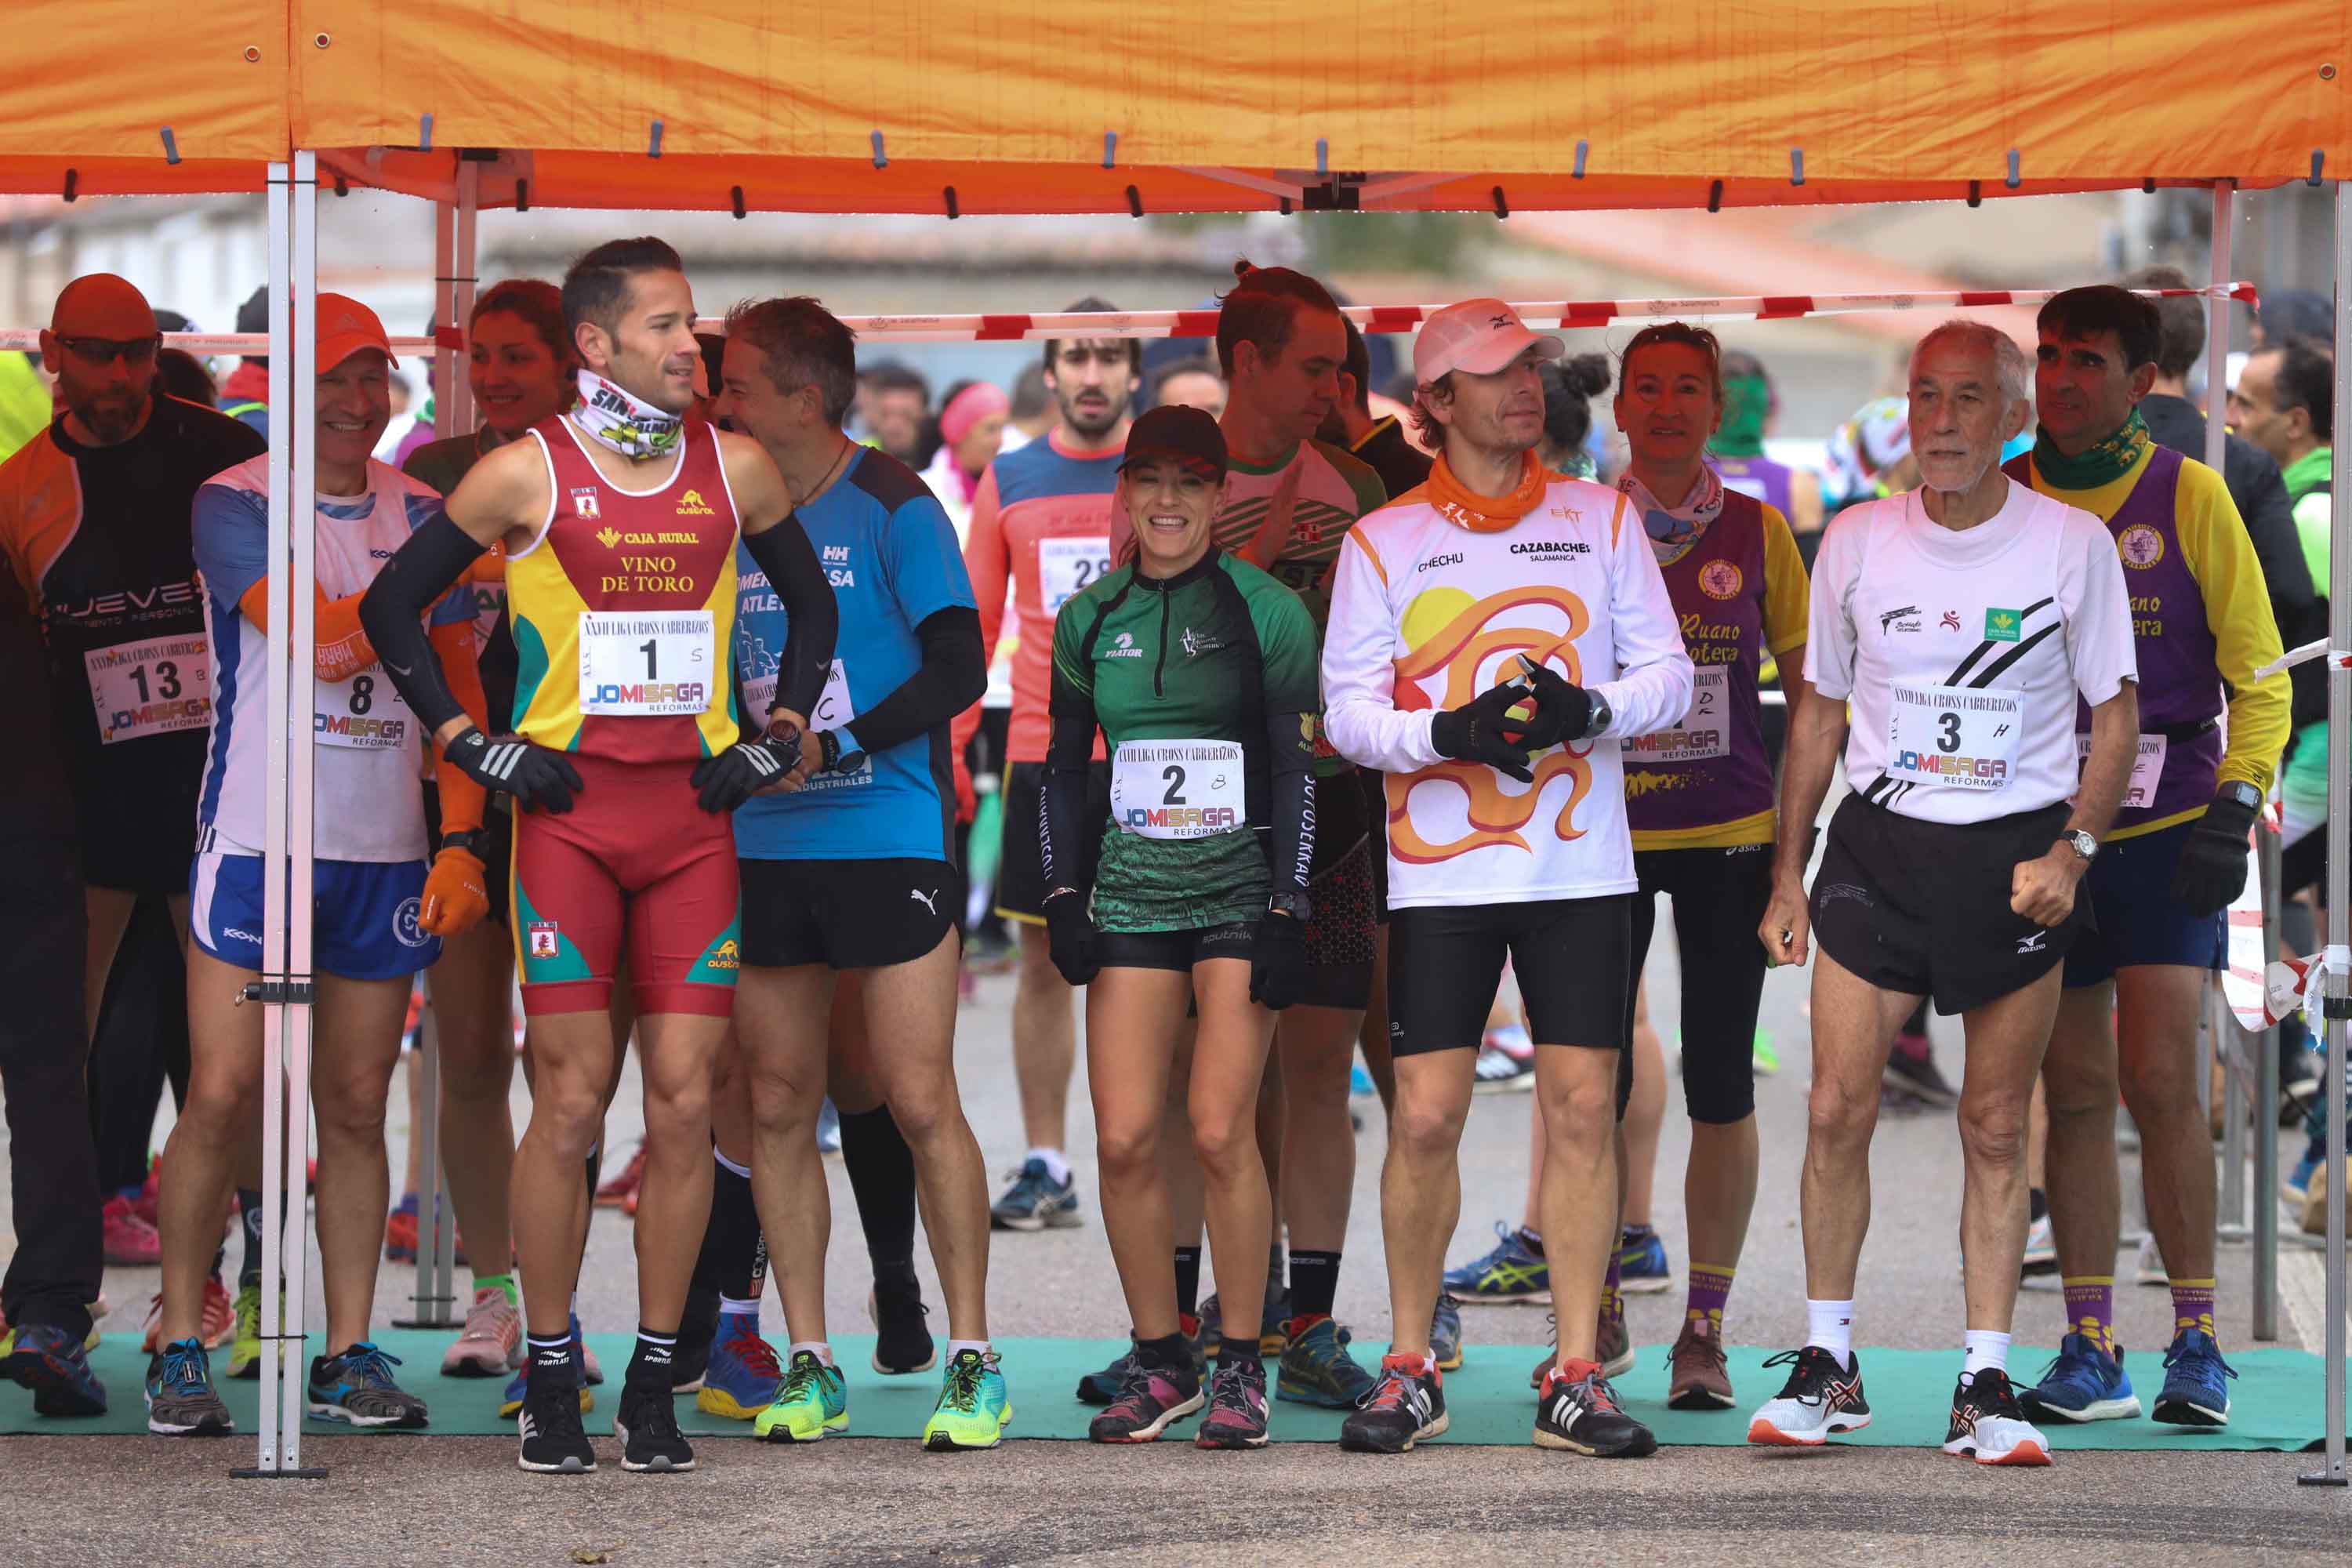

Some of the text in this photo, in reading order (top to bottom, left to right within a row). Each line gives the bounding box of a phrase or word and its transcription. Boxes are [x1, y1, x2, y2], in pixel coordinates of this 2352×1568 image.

[624, 532, 699, 545] CAJA RURAL
[620, 556, 677, 572] VINO
[1417, 552, 1465, 573] CHECHU
[1530, 554, 1576, 563] SALAMANCA
[601, 575, 694, 593] DE TORO
[612, 620, 631, 636] LIGA
[633, 620, 659, 636] CROSS
[661, 619, 710, 635] CABRERIZOS
[317, 642, 354, 666] MARA
[640, 638, 657, 680] 1
[1105, 648, 1143, 658] VIATOR
[129, 661, 182, 703] 13
[1694, 673, 1723, 688] ERIZOS
[350, 675, 374, 715] 8
[590, 682, 703, 703] JOMISAGA
[1915, 690, 1932, 707] LIGA
[1933, 693, 1962, 710] CROSS
[1963, 695, 2018, 713] CABRERIZOS
[649, 702, 703, 712] REFORMAS
[160, 715, 211, 729] REFORMA
[314, 713, 405, 739] OMISAGA
[1621, 729, 1719, 753] OMISAGA
[1936, 712, 1962, 753] 3
[352, 737, 403, 748] REFORMAS
[1138, 746, 1156, 763] LIGA
[1157, 746, 1185, 762] CROSS
[1185, 746, 1239, 762] CABRERIZOS
[1661, 747, 1719, 760] REFORMAS
[1893, 750, 2007, 779] JOMISAGA
[1162, 764, 1186, 805] 2
[1944, 775, 2005, 789] REFORMAS
[1123, 808, 1235, 828] JOMISAGA
[1174, 827, 1229, 837] REFORMA
